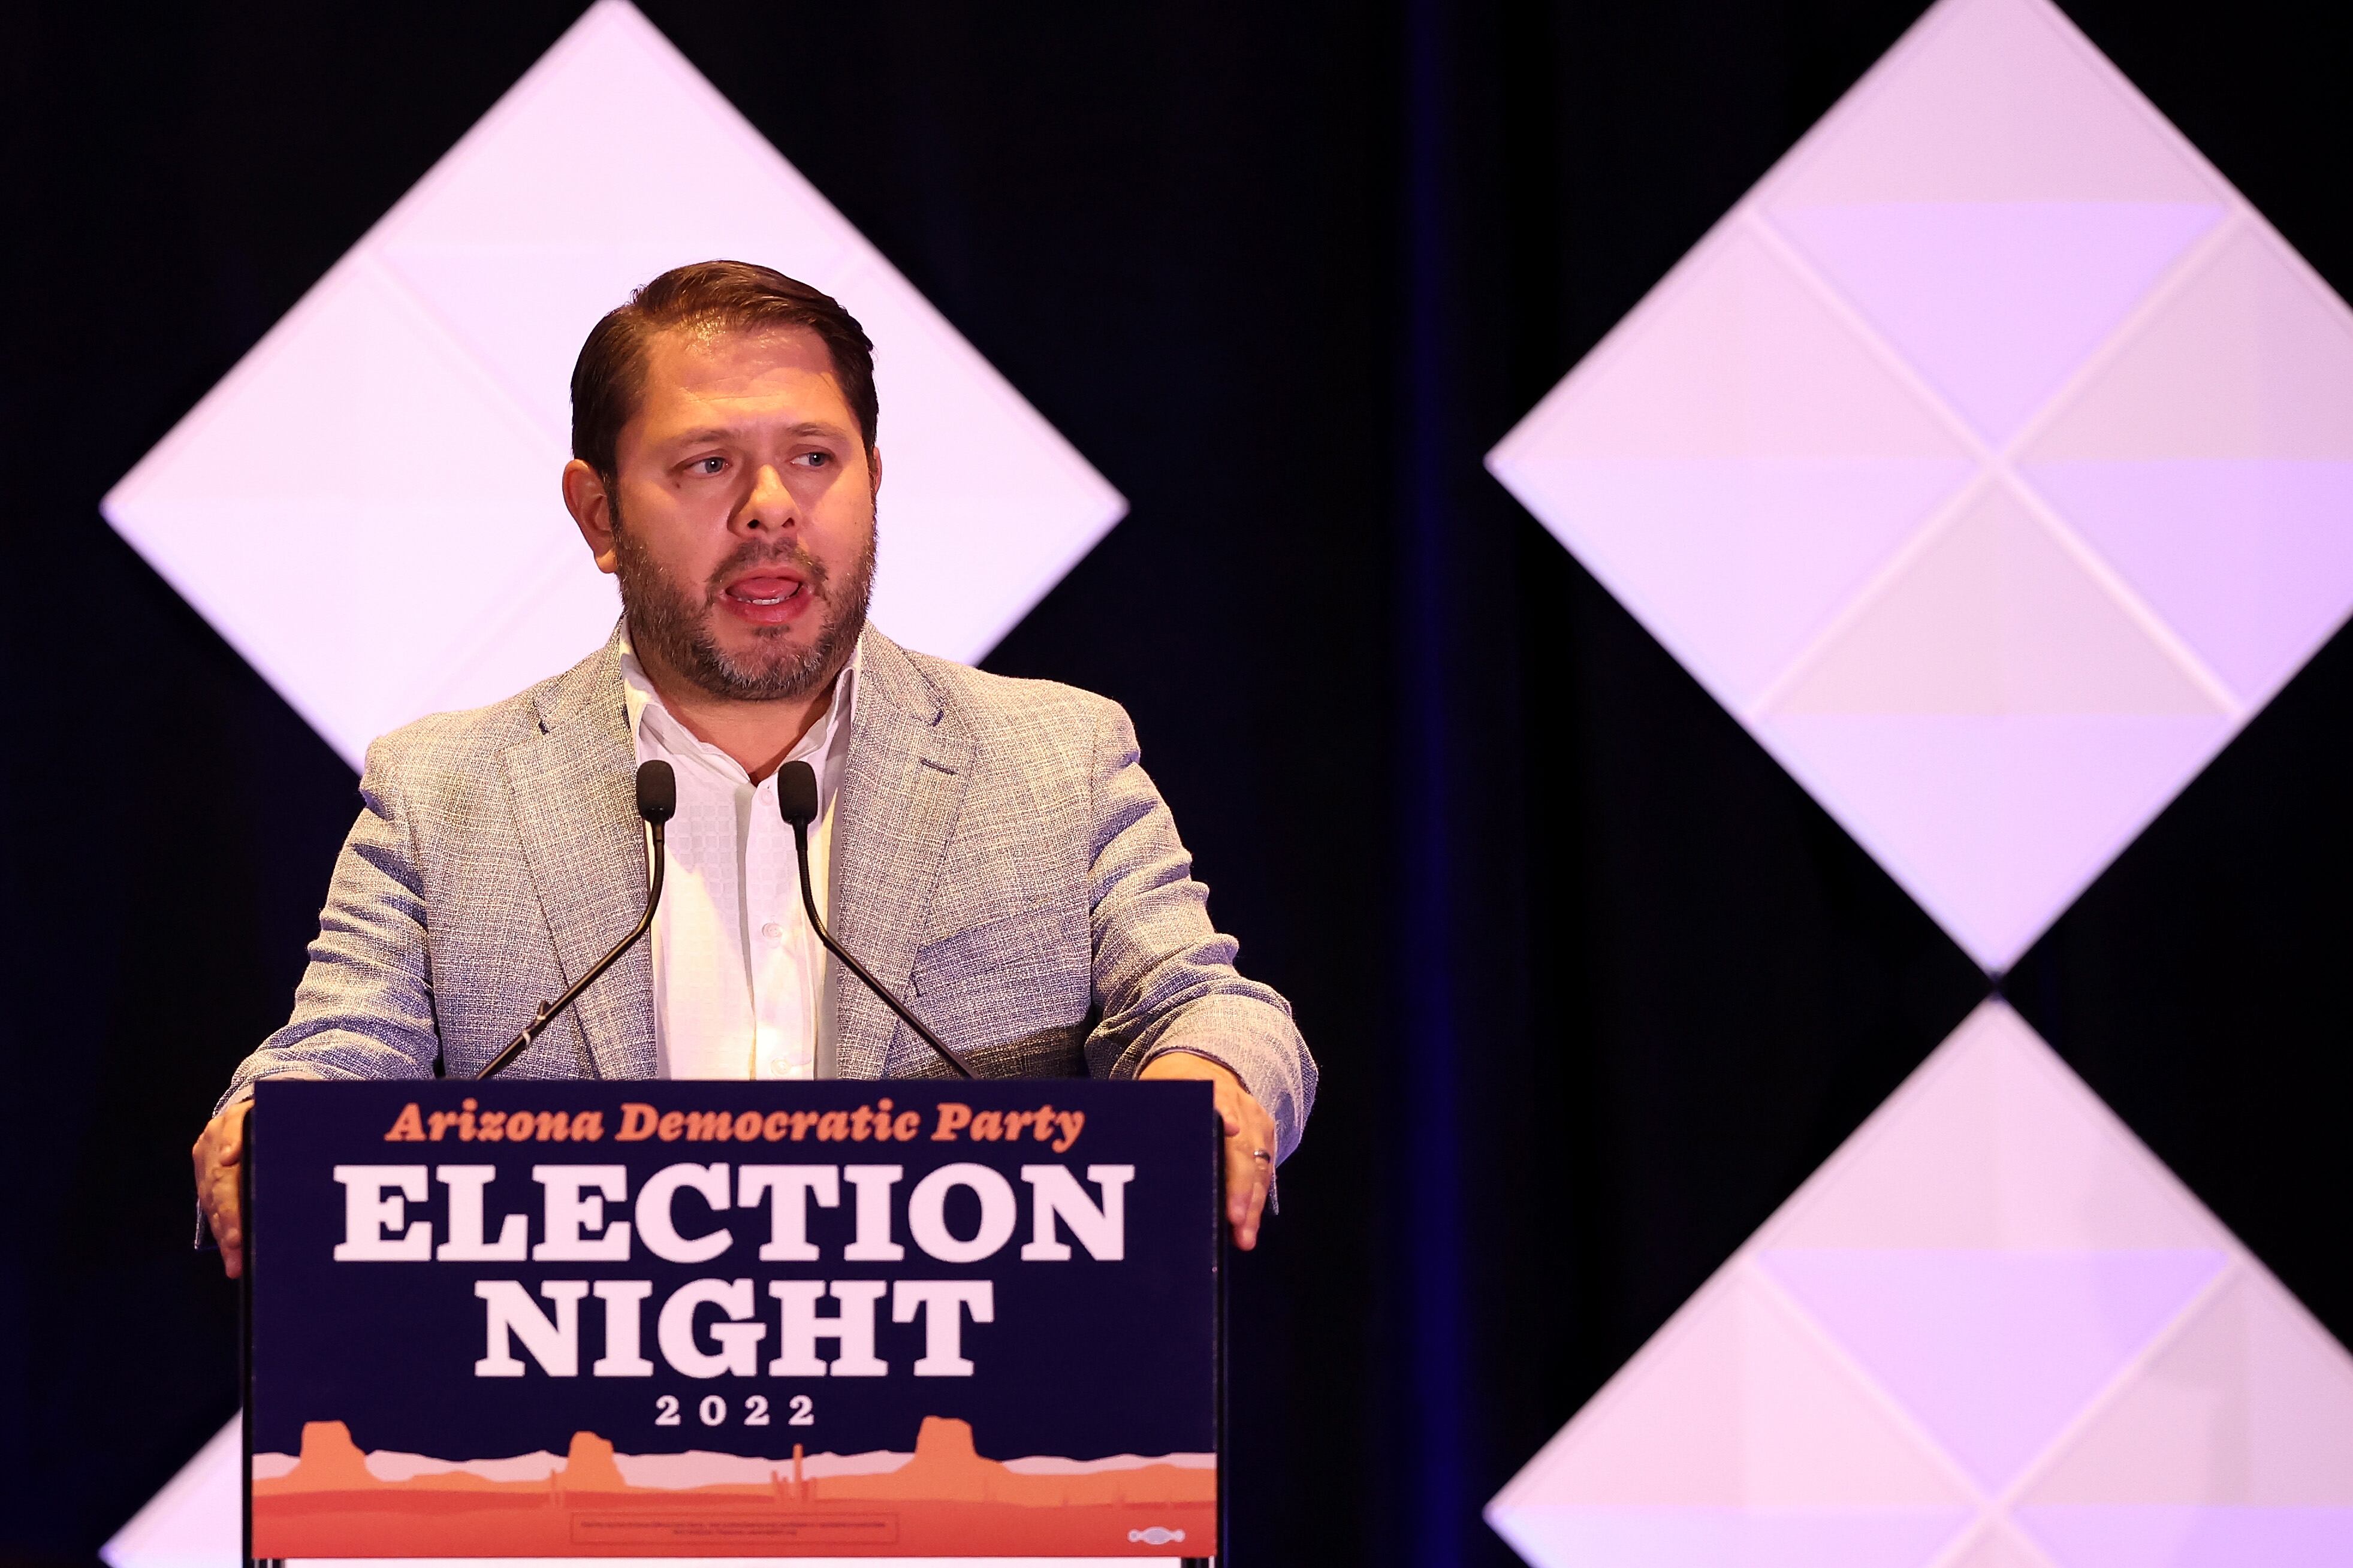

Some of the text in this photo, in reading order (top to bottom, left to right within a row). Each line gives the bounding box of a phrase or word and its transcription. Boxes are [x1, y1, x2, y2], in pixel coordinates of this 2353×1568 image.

[385, 1098, 1084, 1153] Arizona Democratic Party
[334, 1163, 1135, 1263] ELECTION
[475, 1279, 994, 1378] NIGHT
[656, 1395, 814, 1425] 2022
